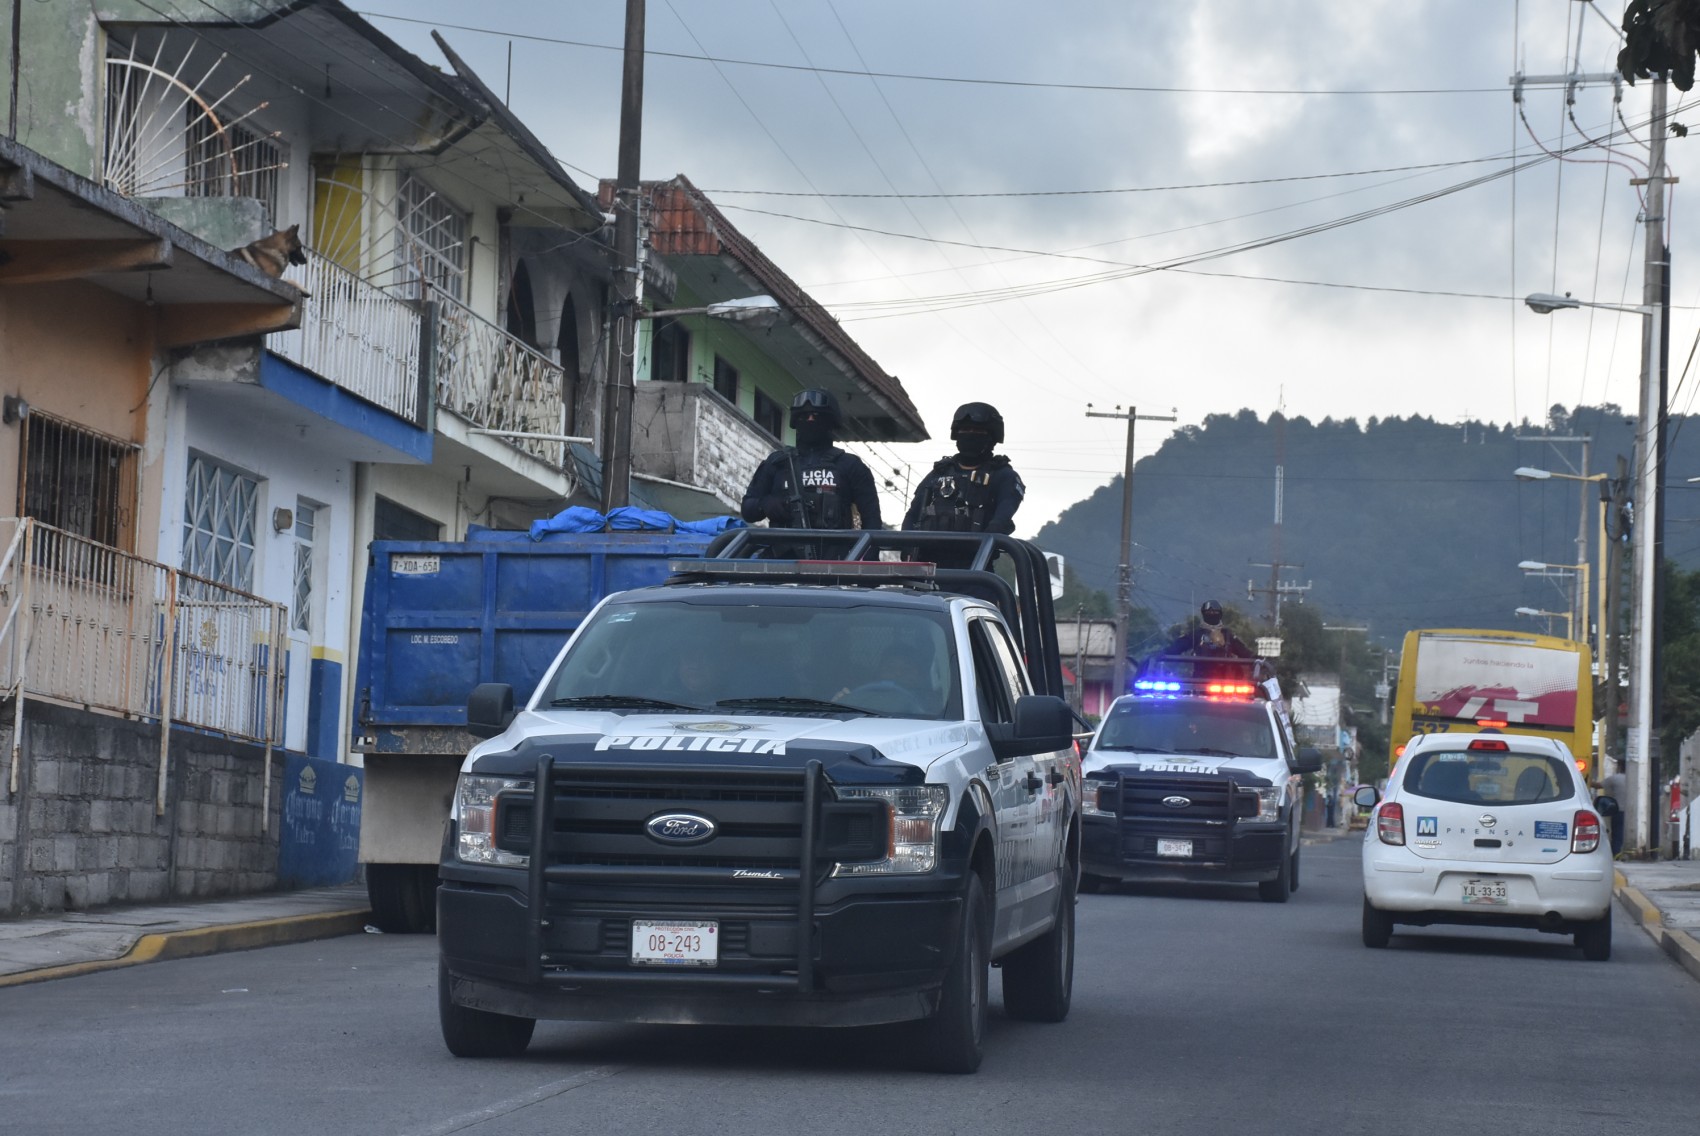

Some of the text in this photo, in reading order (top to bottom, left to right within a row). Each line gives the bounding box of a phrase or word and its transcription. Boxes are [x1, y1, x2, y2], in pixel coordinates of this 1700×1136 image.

[802, 469, 835, 479] LICÍA
[802, 478, 837, 487] TATAL
[594, 735, 786, 756] POLICIA
[1139, 763, 1219, 775] POLICIA
[662, 819, 699, 836] Ford
[1418, 819, 1435, 834] M
[1446, 827, 1524, 837] PRENSA
[1463, 886, 1506, 897] YJL-33-33
[649, 934, 701, 952] 08-243
